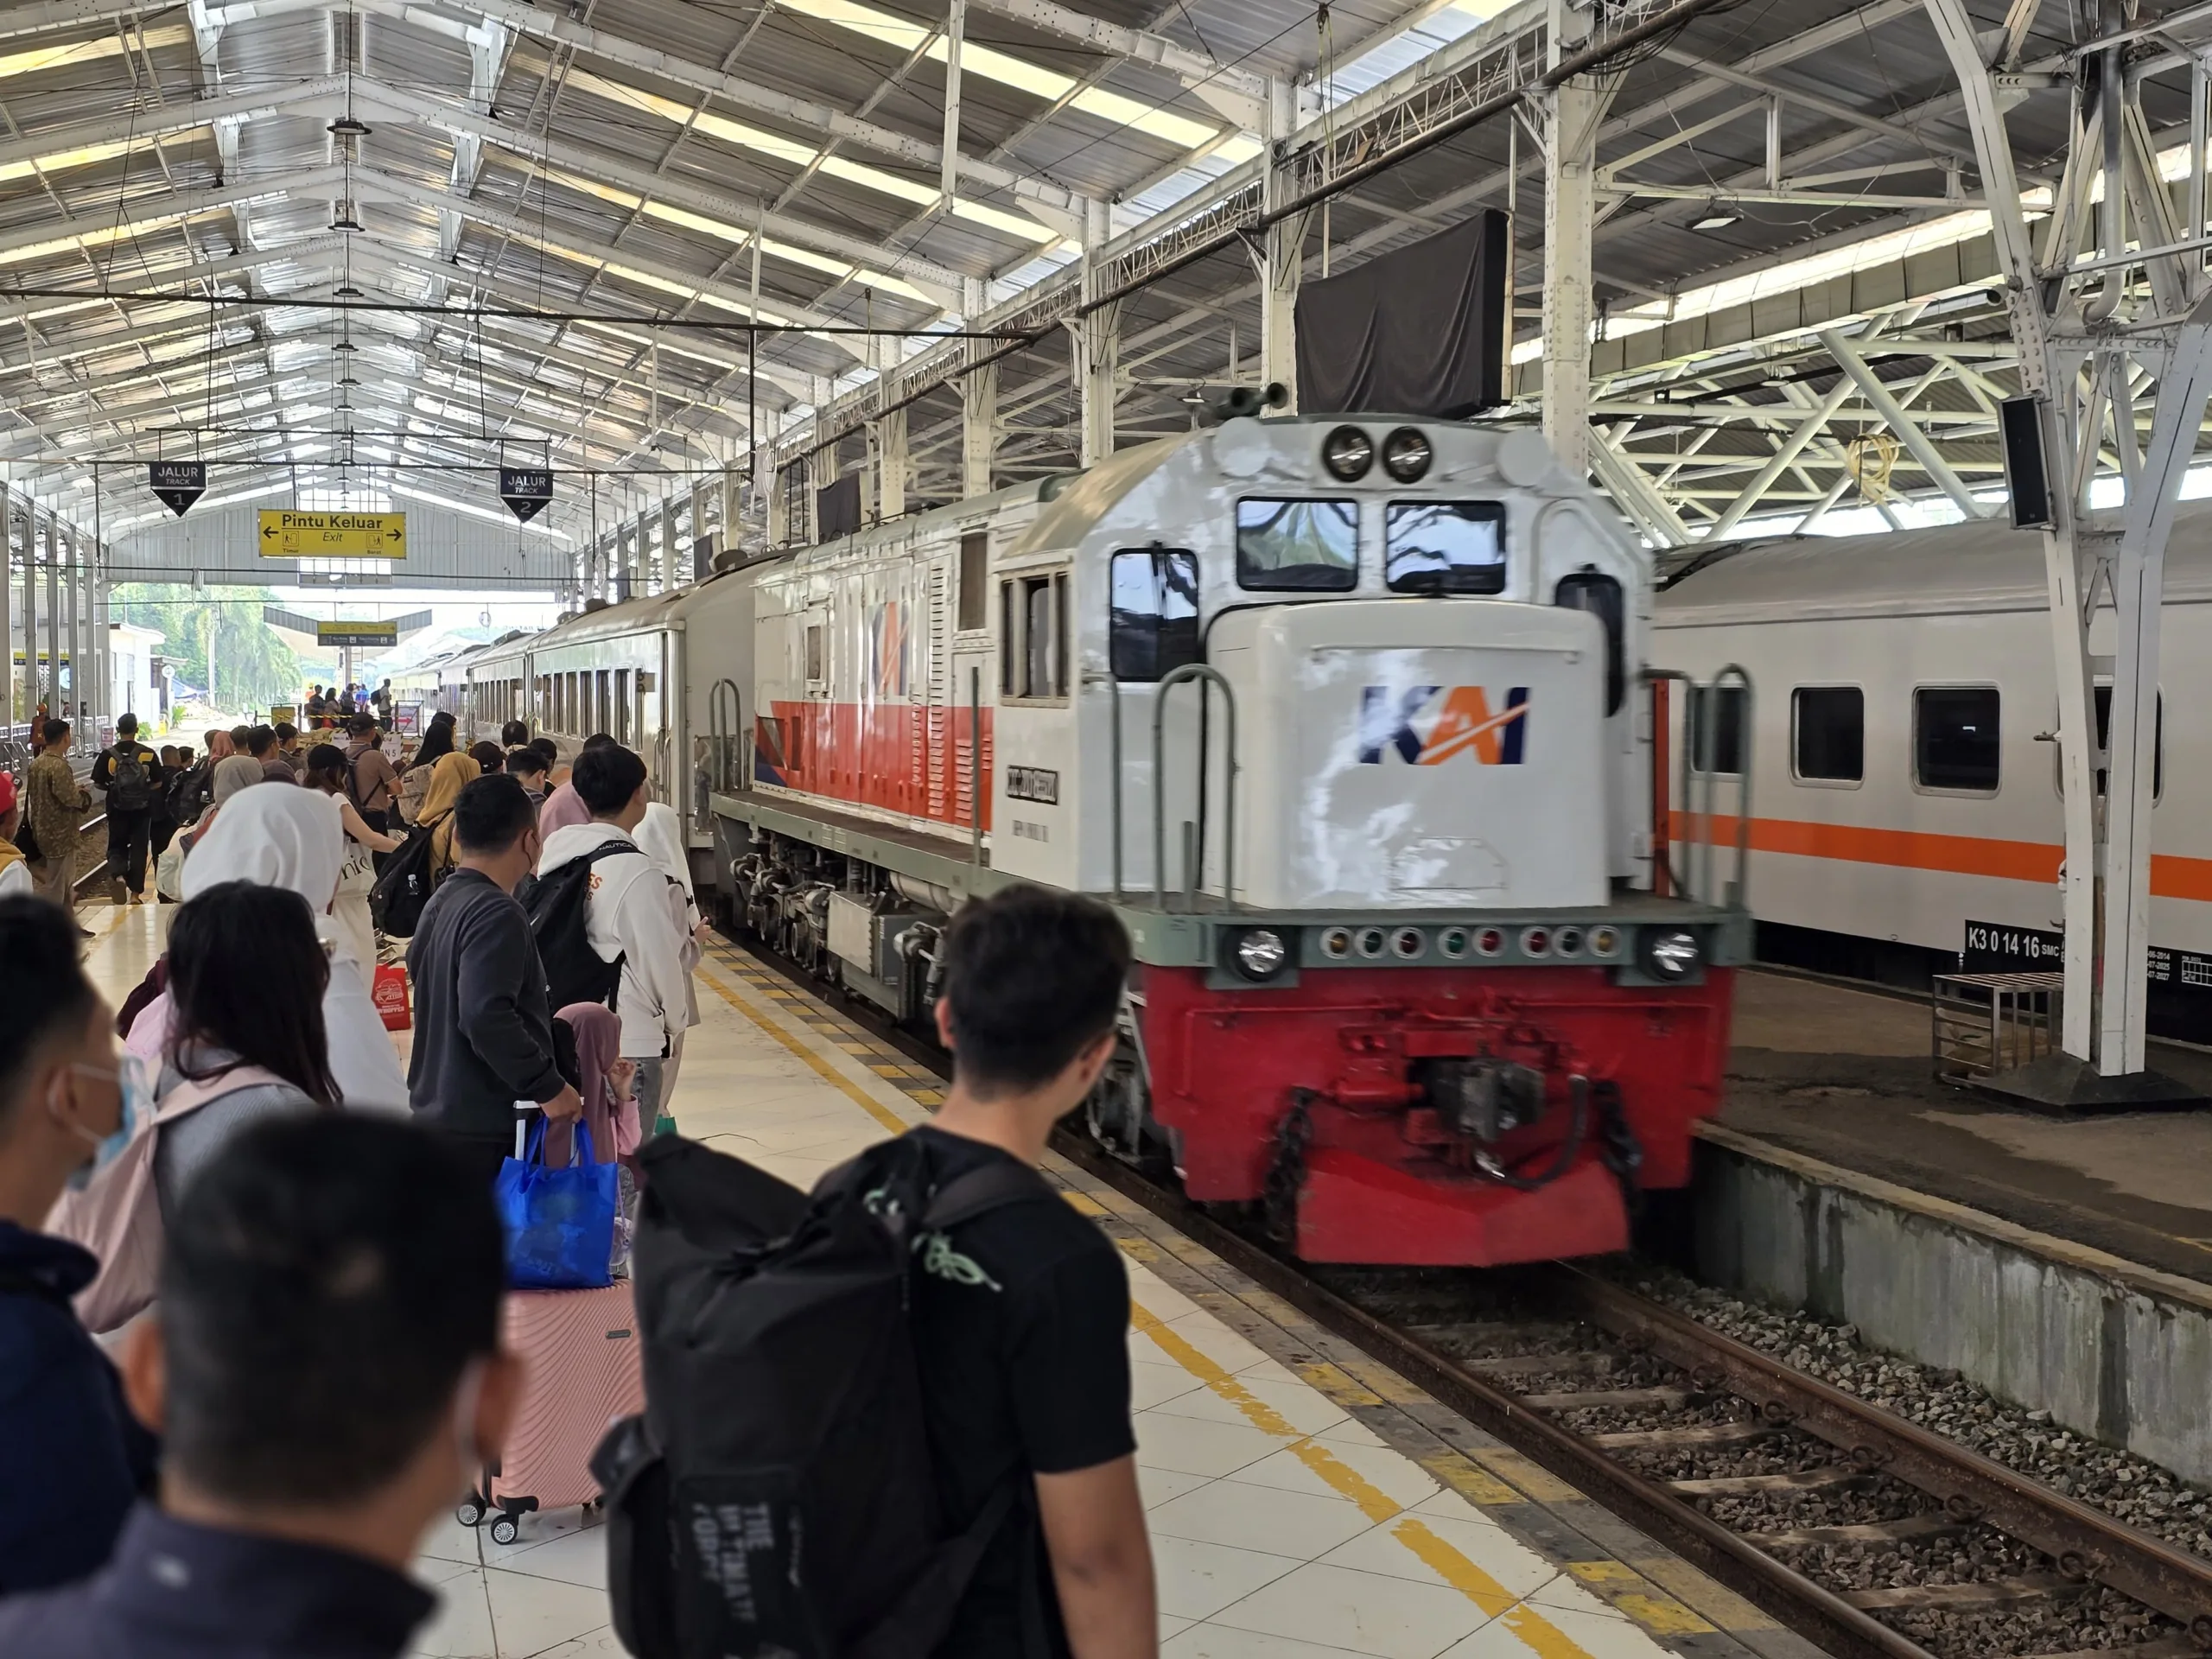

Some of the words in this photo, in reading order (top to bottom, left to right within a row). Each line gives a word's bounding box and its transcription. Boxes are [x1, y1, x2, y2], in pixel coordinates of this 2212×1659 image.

[158, 467, 198, 477] JALUR
[508, 475, 546, 486] JALUR
[174, 493, 186, 505] 1
[520, 501, 531, 513] 2
[282, 514, 324, 528] Pintu
[329, 515, 383, 529] Keluar
[322, 531, 343, 543] Exit
[1358, 685, 1531, 766] KAI
[599, 842, 632, 851] NAUTICA
[1968, 926, 1986, 950] K3
[1990, 931, 1999, 952] 0
[2002, 932, 2019, 955] 14
[2023, 935, 2040, 958] 16
[2041, 944, 2060, 957] SMC
